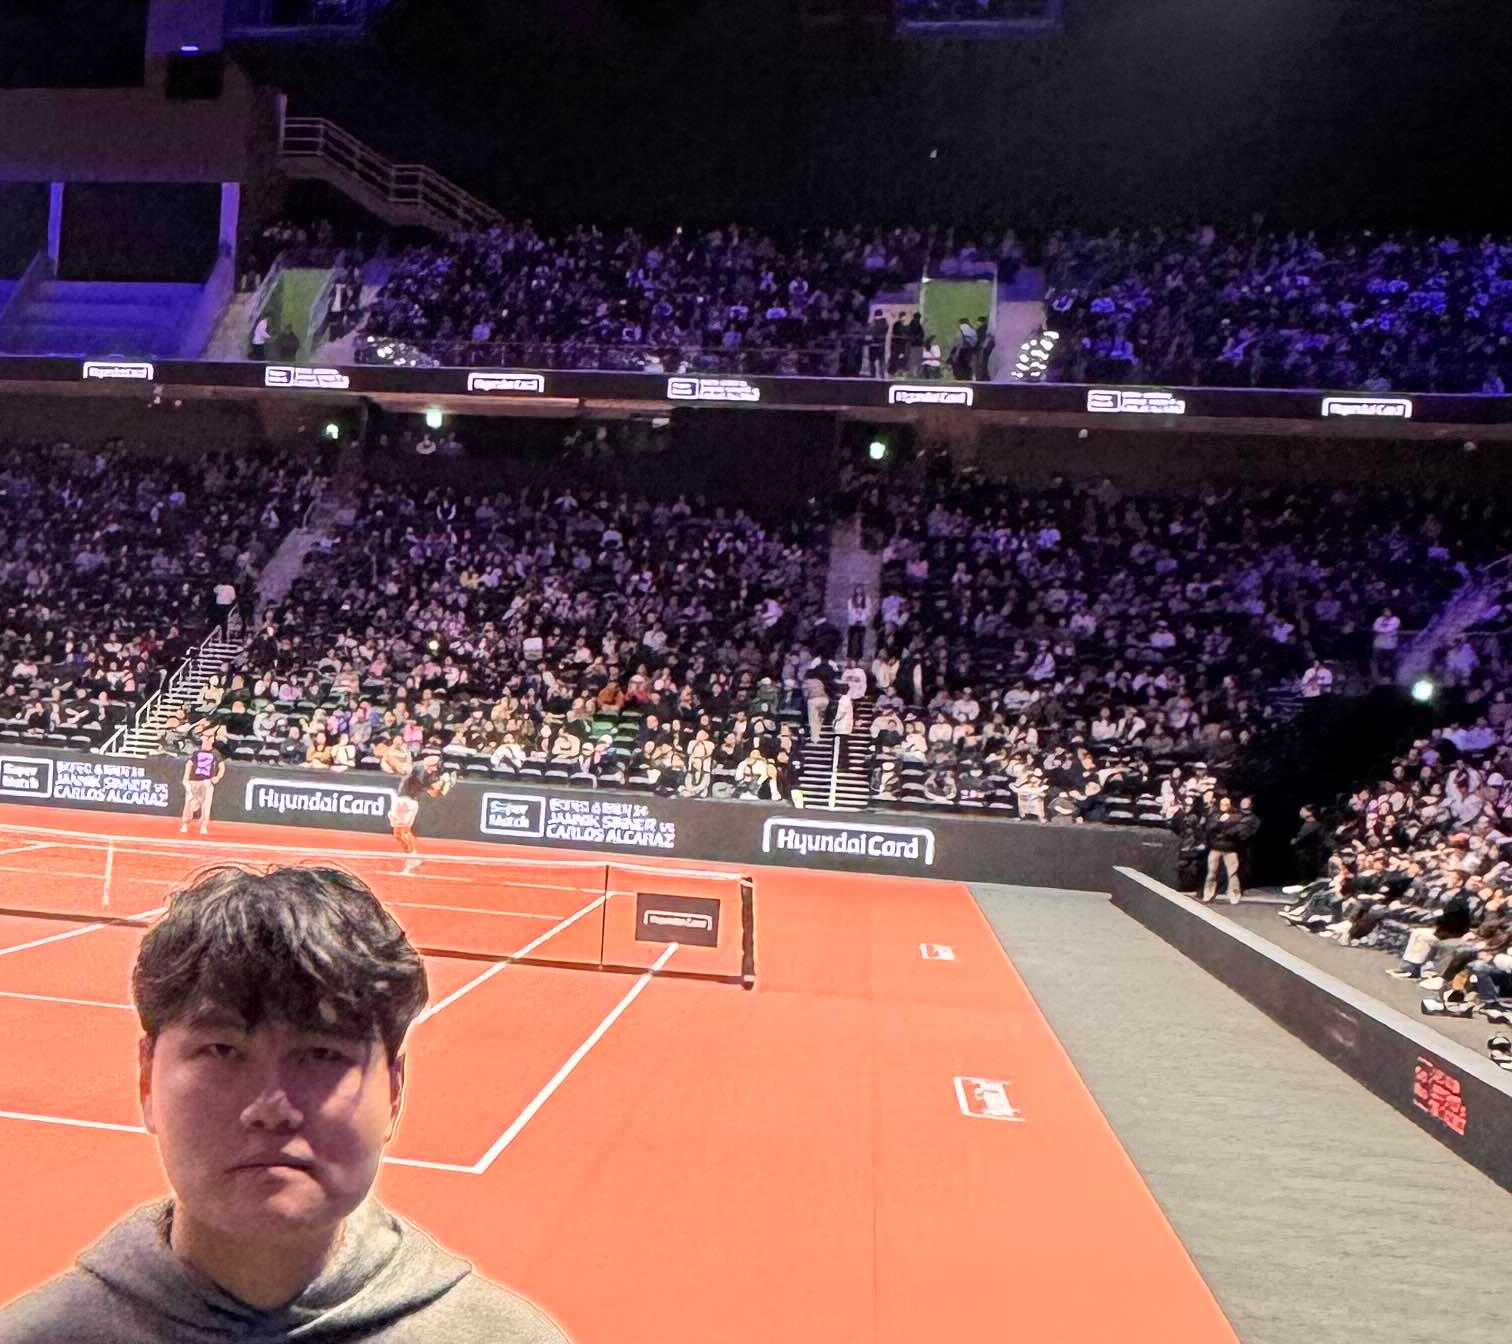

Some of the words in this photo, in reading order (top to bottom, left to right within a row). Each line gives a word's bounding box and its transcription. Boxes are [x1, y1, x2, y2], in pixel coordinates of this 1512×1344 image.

[54, 785, 106, 802] CARLOS
[106, 789, 169, 807] ALCARAZ
[259, 787, 338, 813] Hyundai
[340, 794, 384, 816] Card
[546, 824, 605, 842] CARLOS
[605, 830, 676, 848] ALCARAZ
[777, 828, 866, 855] Hyundai
[868, 835, 919, 858] Card
